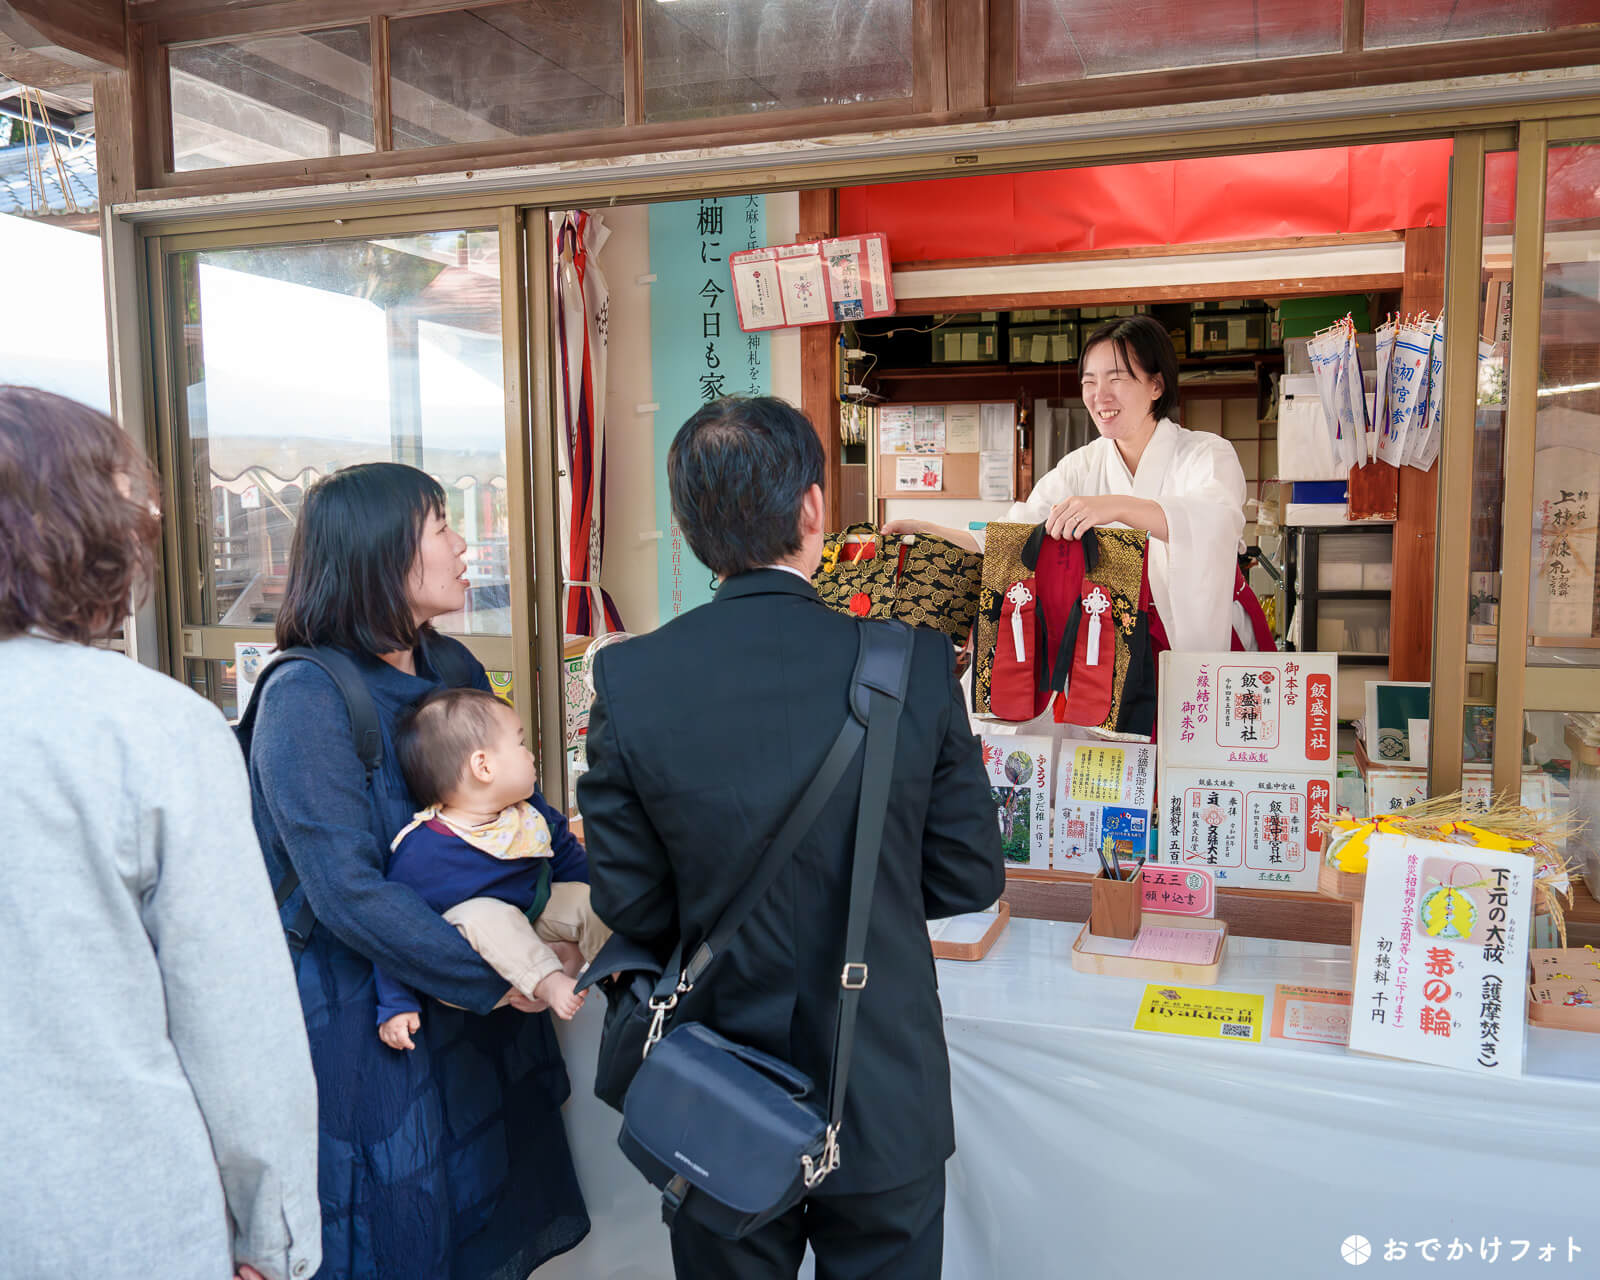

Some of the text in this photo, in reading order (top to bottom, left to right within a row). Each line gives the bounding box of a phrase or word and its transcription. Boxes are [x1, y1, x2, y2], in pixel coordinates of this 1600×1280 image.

[698, 278, 726, 401] 今日も家
[1390, 362, 1415, 444] 初宮参り
[670, 512, 683, 616] 頒布百五十周年
[1196, 663, 1210, 724] ご縁結びの
[1240, 672, 1260, 743] 飯盛神社
[1283, 661, 1300, 706] 御本宮
[1309, 682, 1329, 752] 飯盛三社
[1180, 701, 1196, 744] 御朱印
[1036, 753, 1047, 789] ふくろう
[1309, 785, 1329, 838] 御朱印
[1371, 936, 1394, 1025] 初穂料 千円
